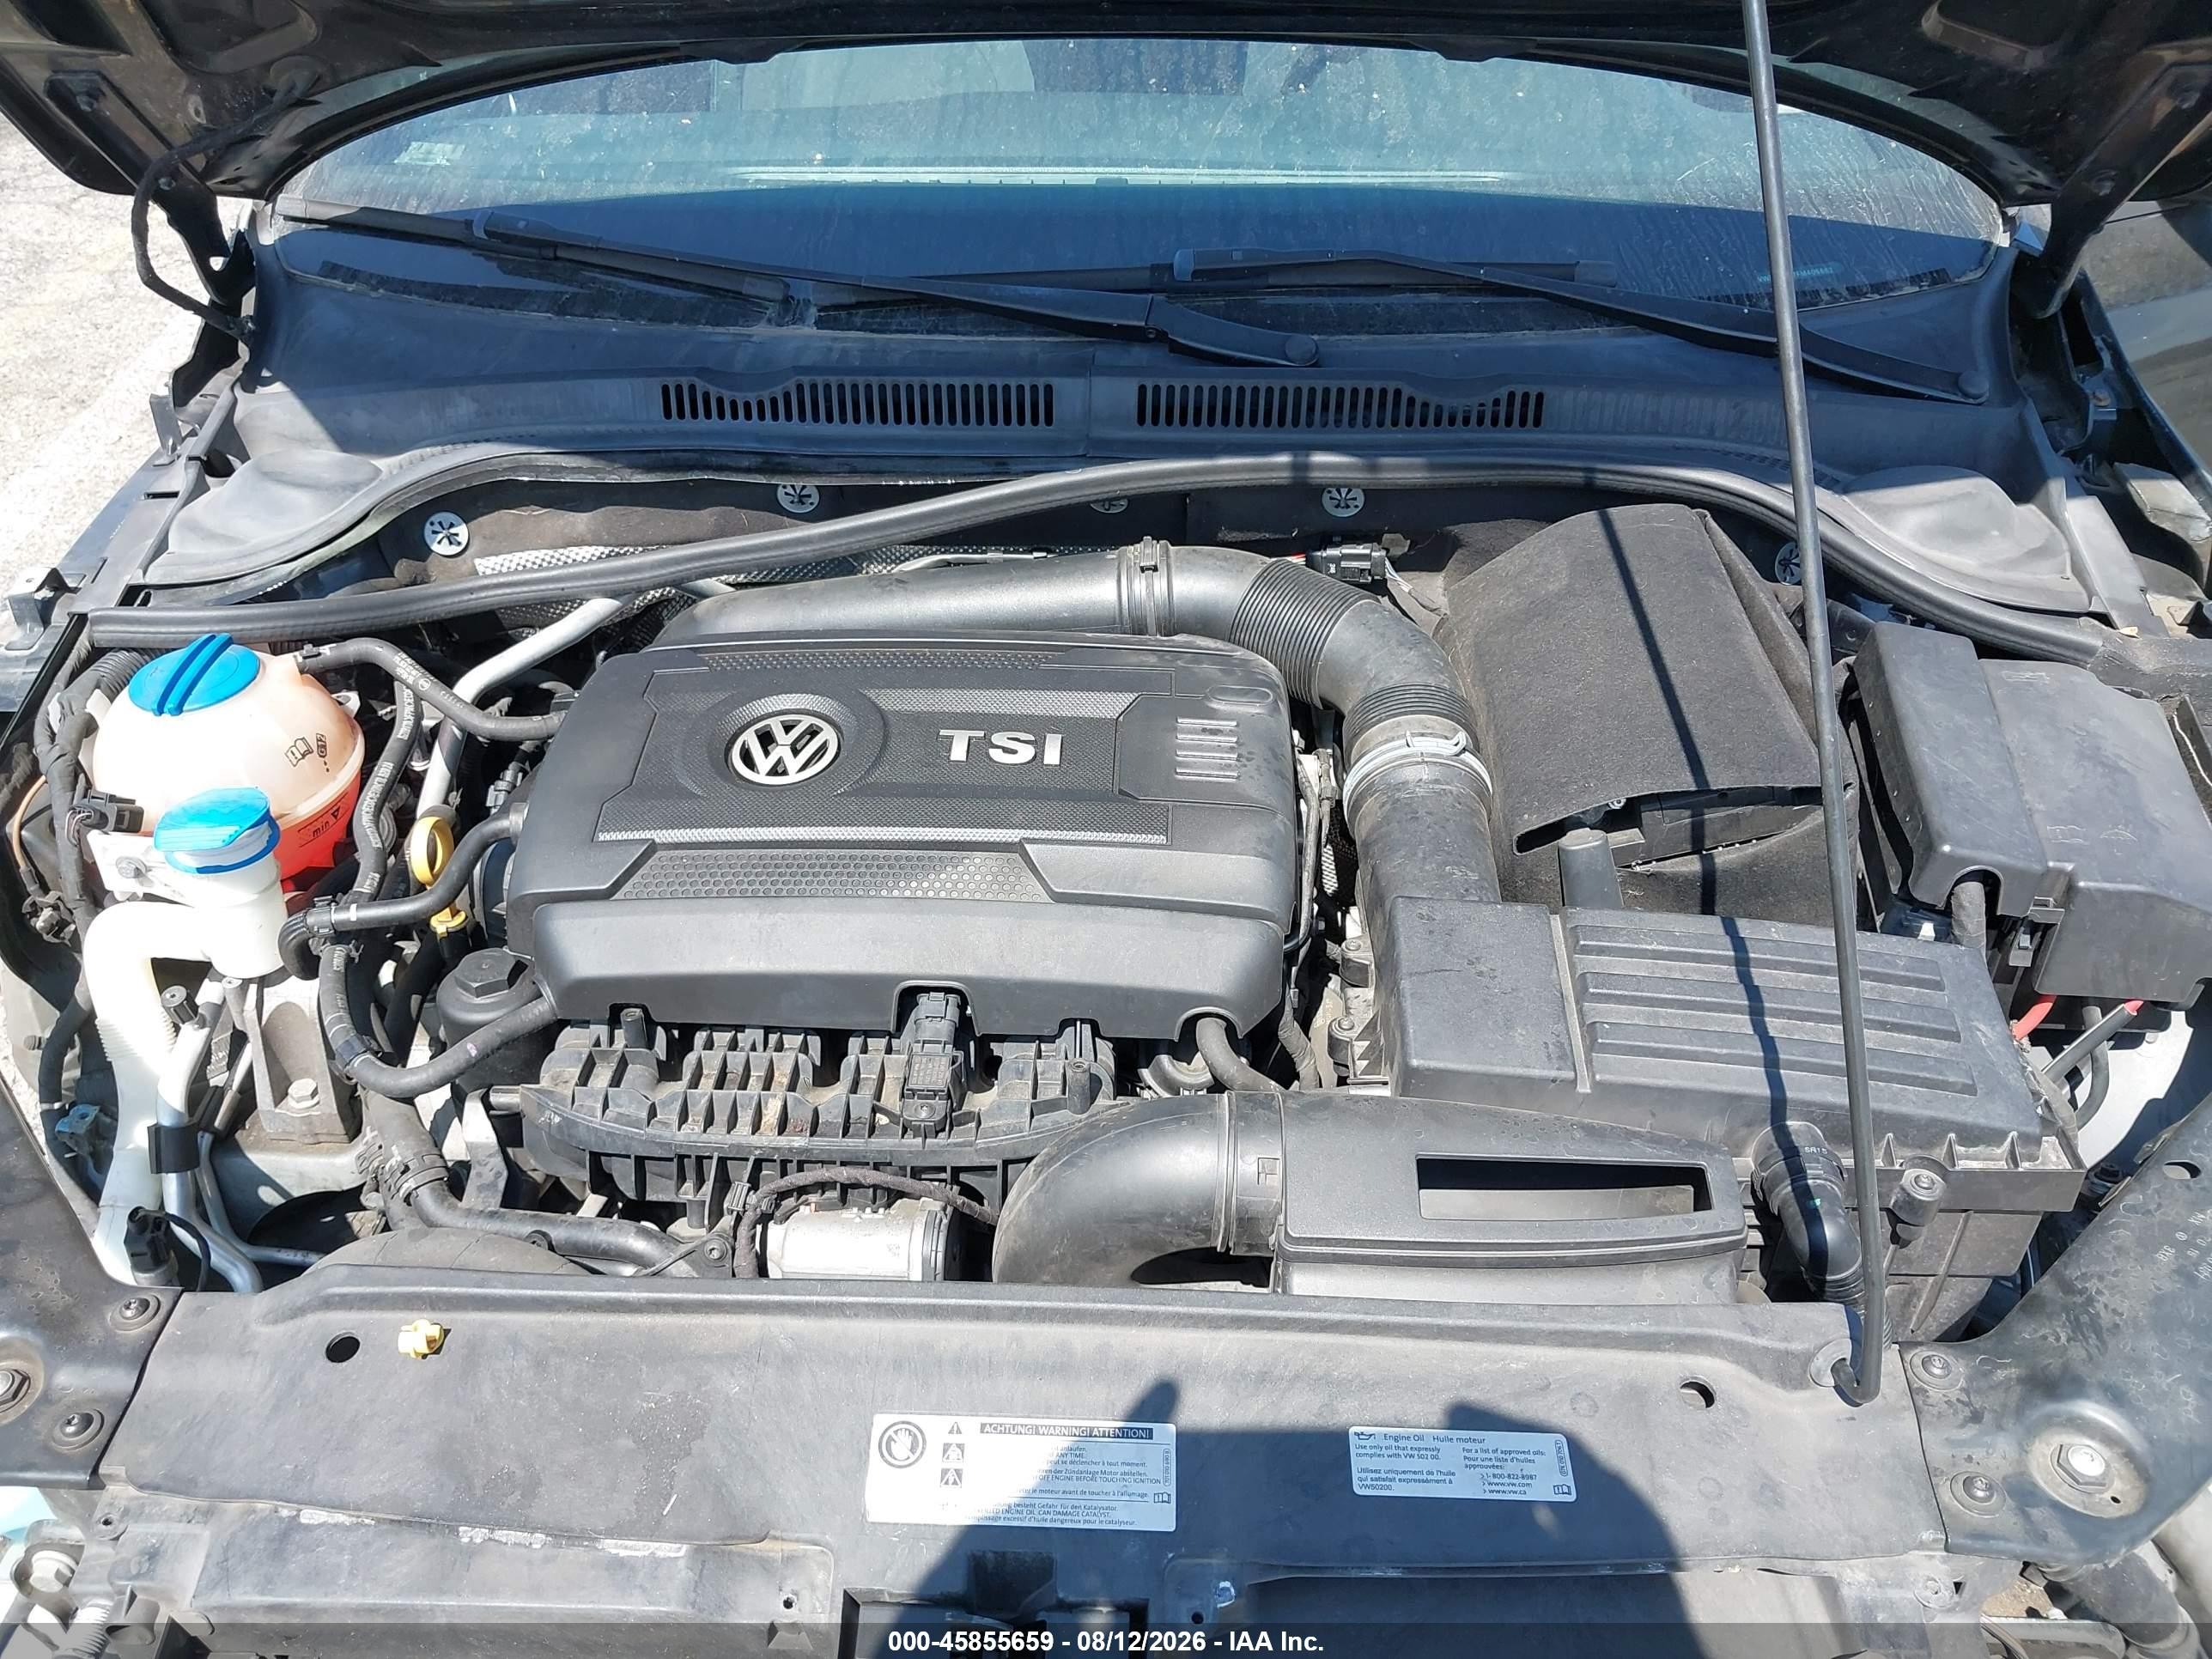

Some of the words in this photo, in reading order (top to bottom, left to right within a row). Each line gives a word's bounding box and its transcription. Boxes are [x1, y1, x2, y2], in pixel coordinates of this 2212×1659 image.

[939, 729, 1063, 766] TSI
[313, 820, 330, 838] min
[984, 1424, 1036, 1434] ACHTUNG!
[1038, 1425, 1091, 1437] WARNING!
[1092, 1427, 1150, 1438] ATTENTION!
[1383, 1434, 1412, 1443] Engine
[1433, 1435, 1454, 1443] Huile
[1383, 1468, 1424, 1478] uniquement
[1083, 1504, 1119, 1513] Katalysator.
